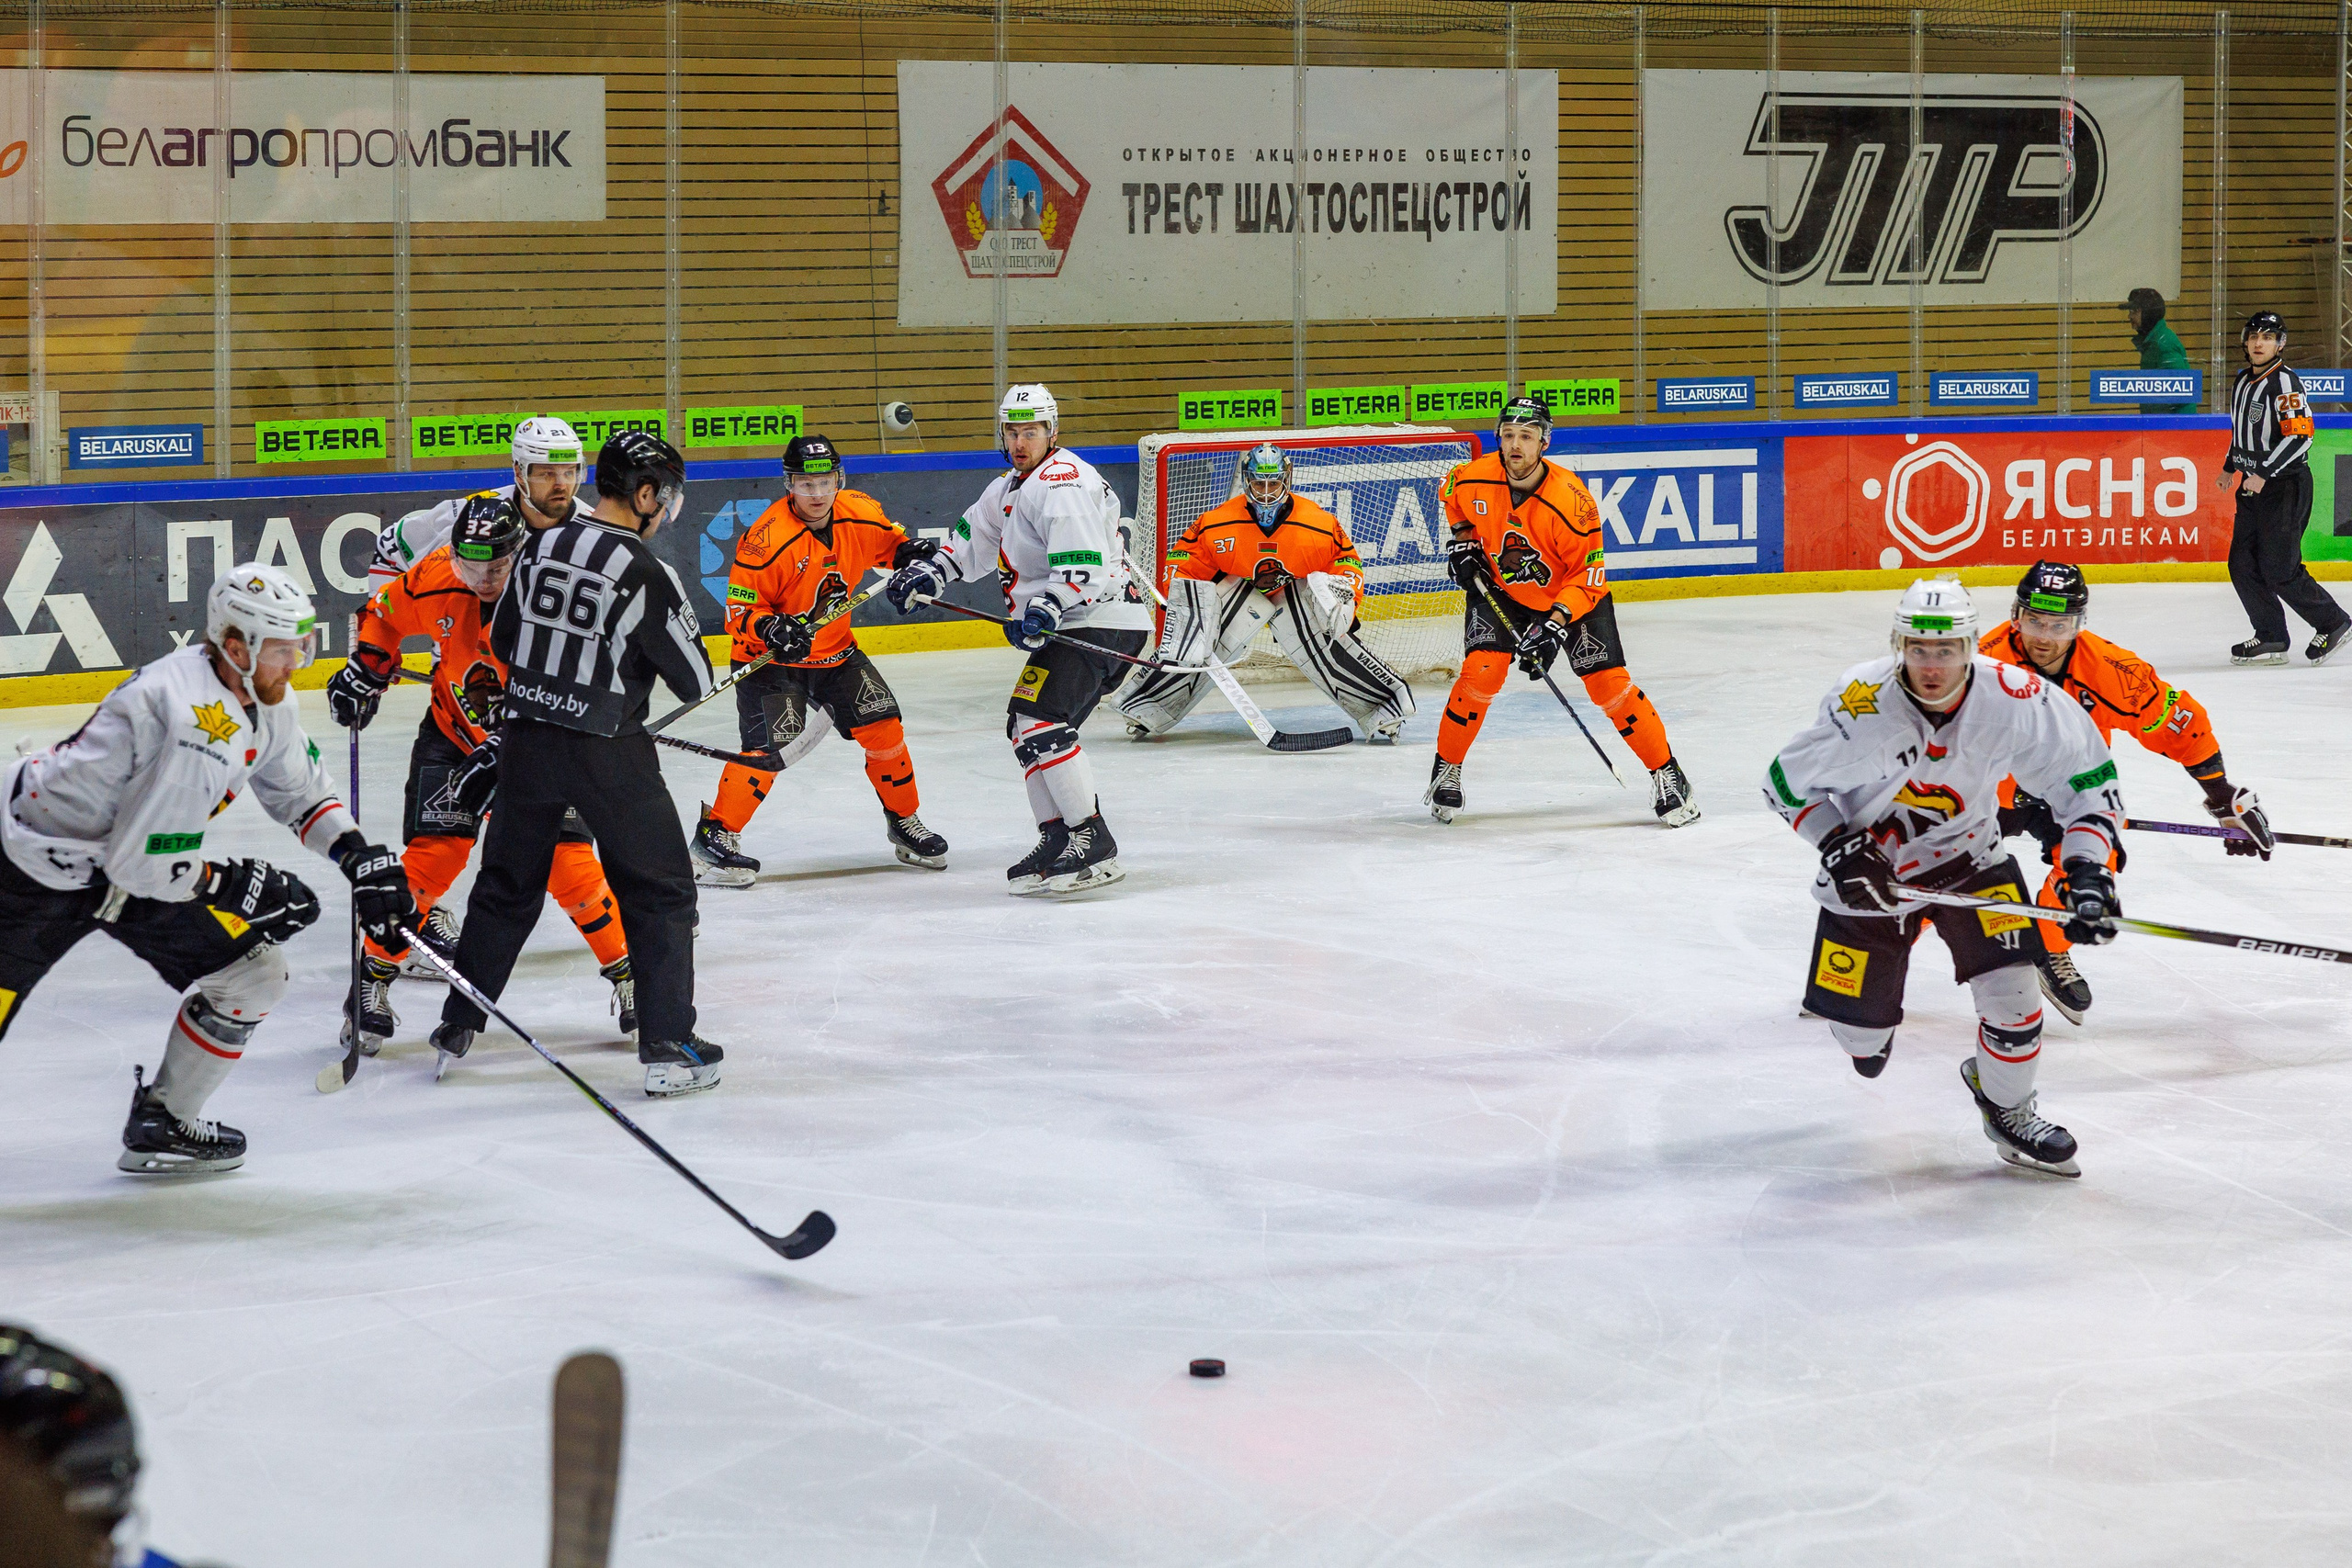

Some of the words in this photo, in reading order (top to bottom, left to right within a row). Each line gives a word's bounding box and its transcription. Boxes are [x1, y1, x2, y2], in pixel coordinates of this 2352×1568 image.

[62, 115, 572, 178] белагропромбанк
[1123, 148, 1235, 163] ОТКРЫТОЕ
[1255, 148, 1407, 164] АКЦИОНЕРНОЕ
[1426, 148, 1531, 164] ОБЩЕСТВО
[1122, 182, 1224, 234] ТРЕСТ
[1235, 170, 1531, 243] ШАХТОСПЕЦСТРОЙ
[1011, 237, 1038, 250] ТРЕСТ
[970, 252, 1057, 270] ШАХСПЕЦСТРОЙ
[1803, 383, 1890, 398] BELARUSKALI
[1939, 383, 2030, 395] BELARUSKALI
[2099, 380, 2193, 393] BELARUSKALI
[2304, 379, 2345, 391] SKALI
[1016, 392, 1029, 402] 12
[1417, 390, 1503, 412] BETERA
[1665, 388, 1747, 401] BELARUSKALI
[2278, 394, 2301, 411] 26
[1184, 399, 1276, 420] BETERA
[1311, 395, 1400, 416] BETERA
[1008, 412, 1035, 420] BETERA
[550, 429, 566, 437] 21
[571, 419, 662, 444] ETERA
[693, 414, 797, 438] BETERA
[263, 427, 379, 453] BETERA
[419, 423, 516, 447] BETER
[80, 437, 193, 456] BELARUSKALI
[806, 443, 826, 455] 13
[465, 520, 492, 537] 32
[2003, 526, 2199, 548] БЕЛТЭЛЕКАМ
[459, 547, 492, 558] BETERA
[1214, 536, 1236, 554] 37
[1447, 541, 1481, 555] CCM
[1050, 553, 1102, 565] BETERA
[1162, 564, 1179, 583] 37
[1344, 570, 1363, 591] 37
[1586, 567, 1605, 587] 10
[2043, 574, 2064, 590] 15
[284, 582, 300, 597] 8
[530, 567, 605, 631] 66
[1927, 592, 1940, 606] 11
[2032, 596, 2065, 608] BETERA
[822, 596, 863, 622] TACKS
[1914, 618, 1951, 627] BETERA
[1159, 607, 1177, 656] VAUGHN
[1356, 651, 1396, 686] VAUGHN
[509, 676, 590, 717] hockey.by
[2167, 705, 2194, 735] 15
[1896, 745, 1918, 768] 11
[2074, 763, 2117, 789] BETE
[2101, 789, 2124, 811] 11
[422, 812, 473, 825] BELARUSKALI
[2167, 823, 2232, 837] RIBCOR
[1989, 915, 2025, 931] ДРУЖБА
[1820, 976, 1855, 991] ДРУЖБА
